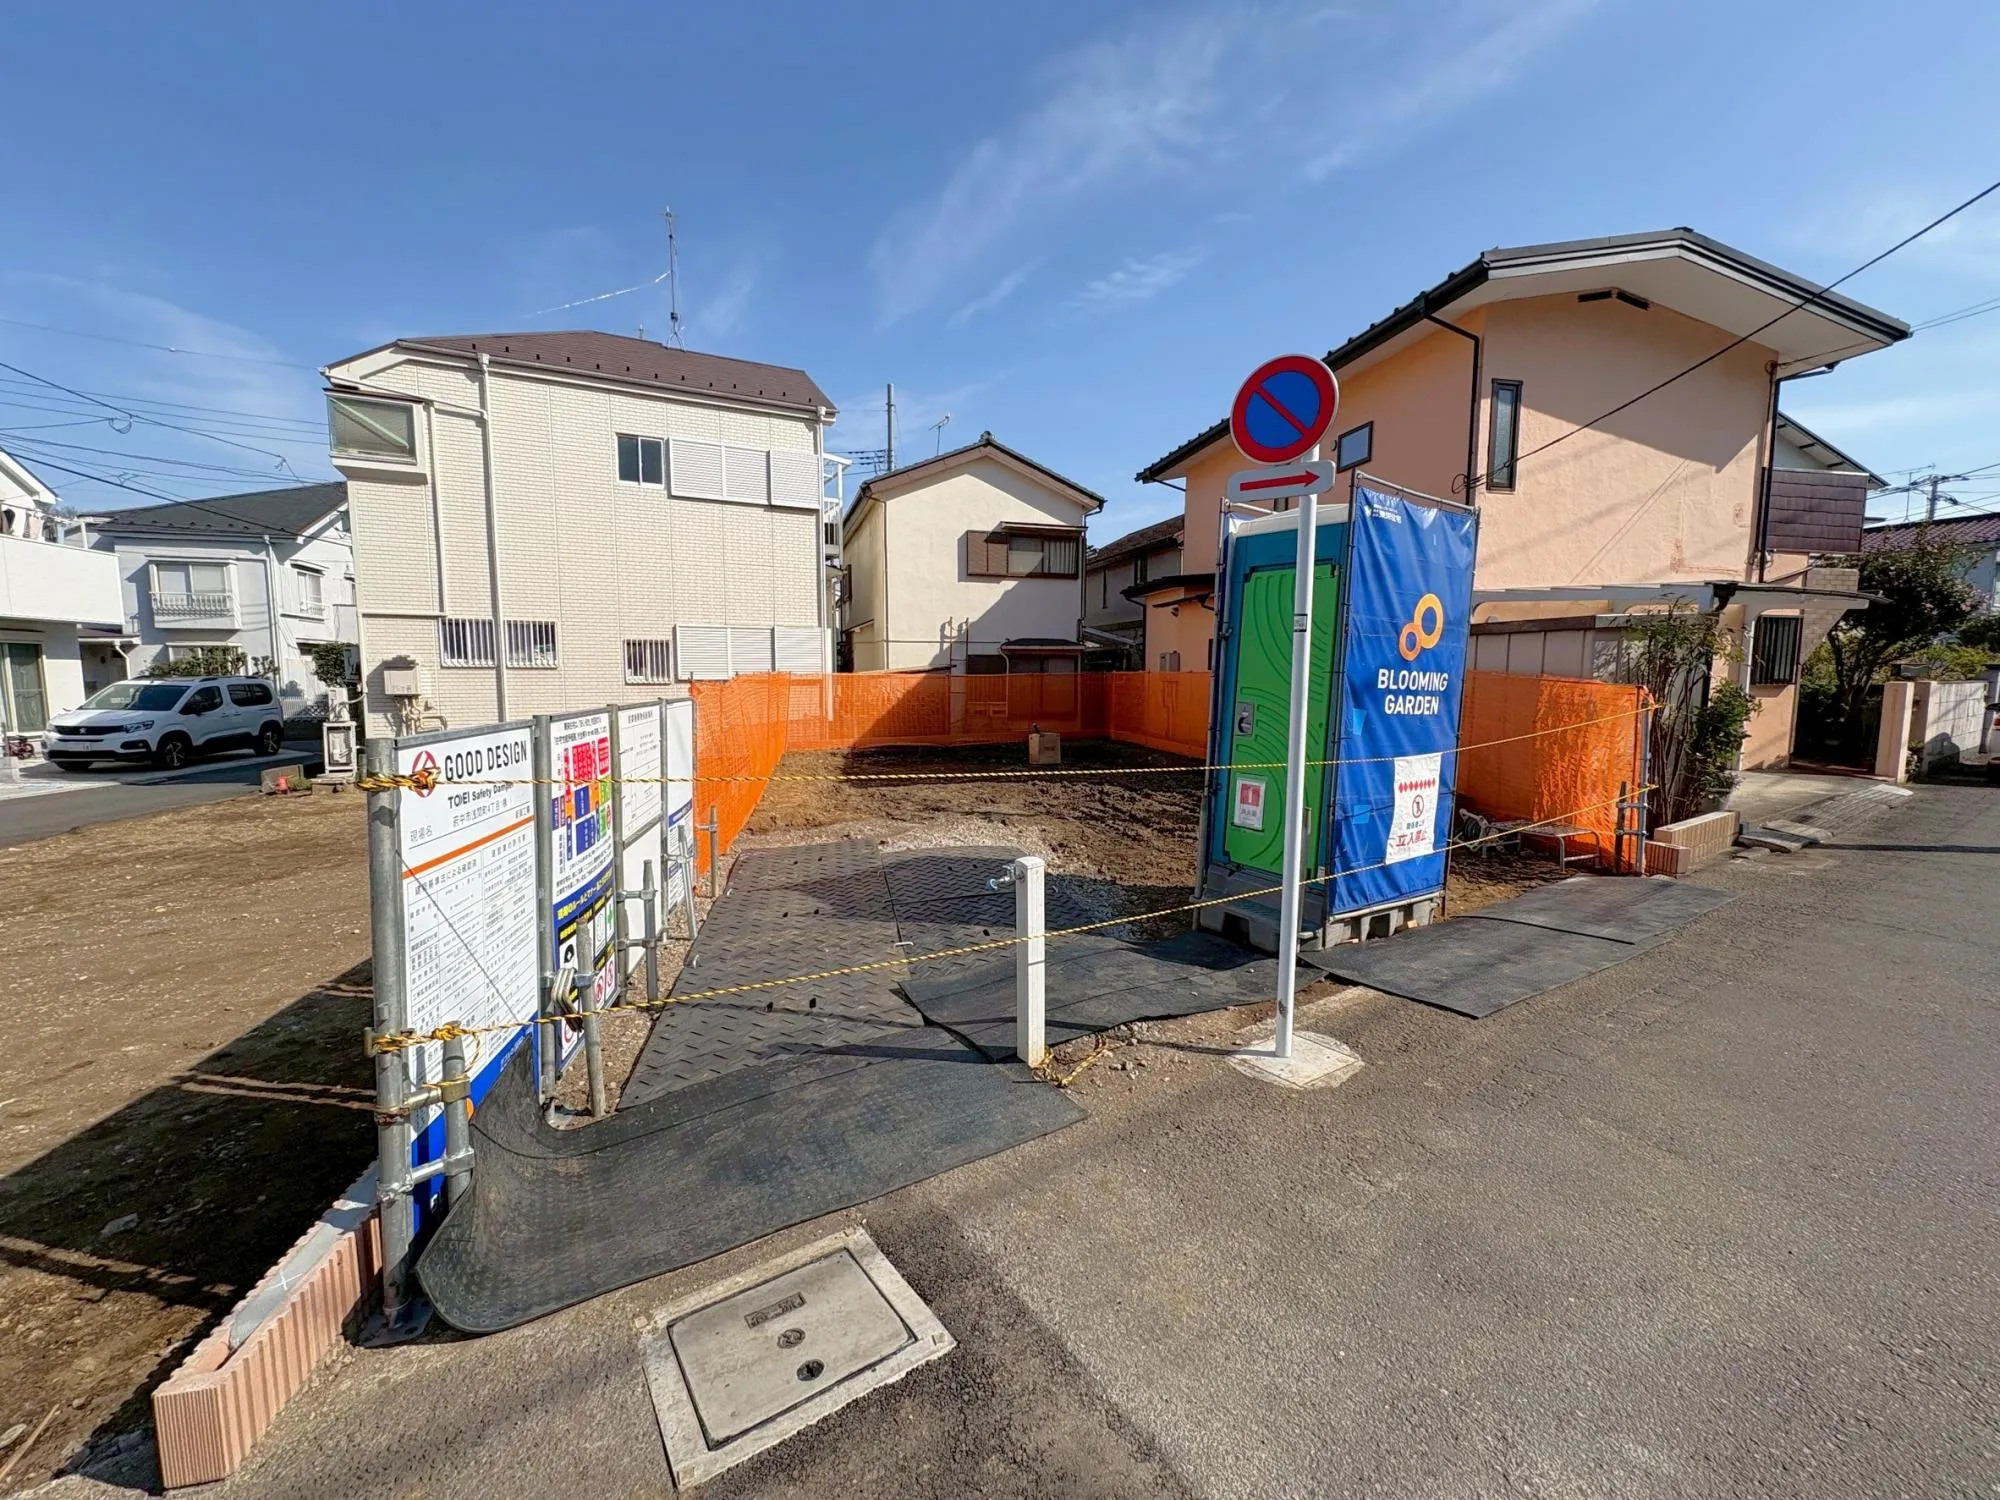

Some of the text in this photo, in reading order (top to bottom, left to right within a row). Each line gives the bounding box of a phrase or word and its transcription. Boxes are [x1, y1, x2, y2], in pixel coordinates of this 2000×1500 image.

[1378, 668, 1448, 691] BLOOMING
[1384, 694, 1439, 715] GARDEN
[444, 750, 483, 781] GOOD
[487, 740, 528, 771] DESIGN
[472, 788, 491, 801] Safety
